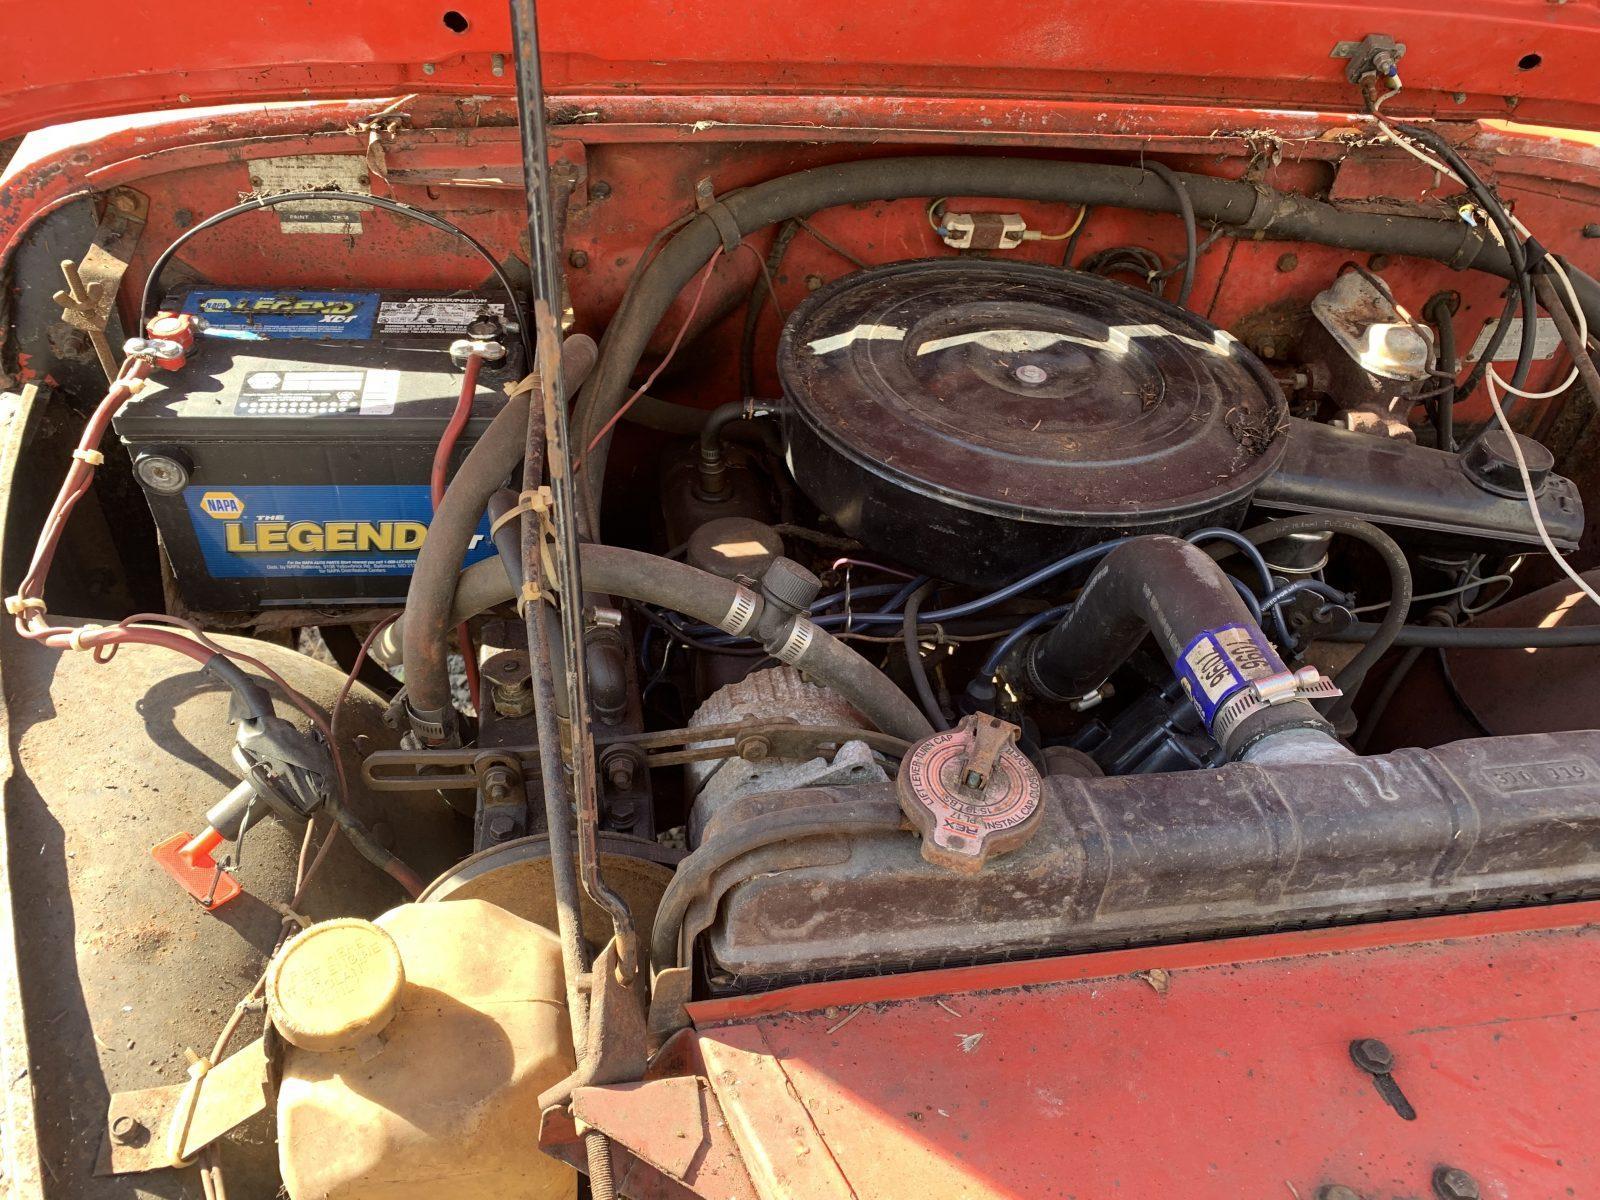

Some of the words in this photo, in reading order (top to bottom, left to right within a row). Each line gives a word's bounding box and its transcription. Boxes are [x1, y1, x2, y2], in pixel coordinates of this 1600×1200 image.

[207, 499, 239, 512] NAPA
[225, 521, 428, 553] LEGEND
[1196, 647, 1231, 688] 7096
[915, 788, 934, 805] LIFT
[933, 734, 953, 745] CAP
[944, 820, 979, 835] REX
[984, 812, 1025, 830] INSTALL
